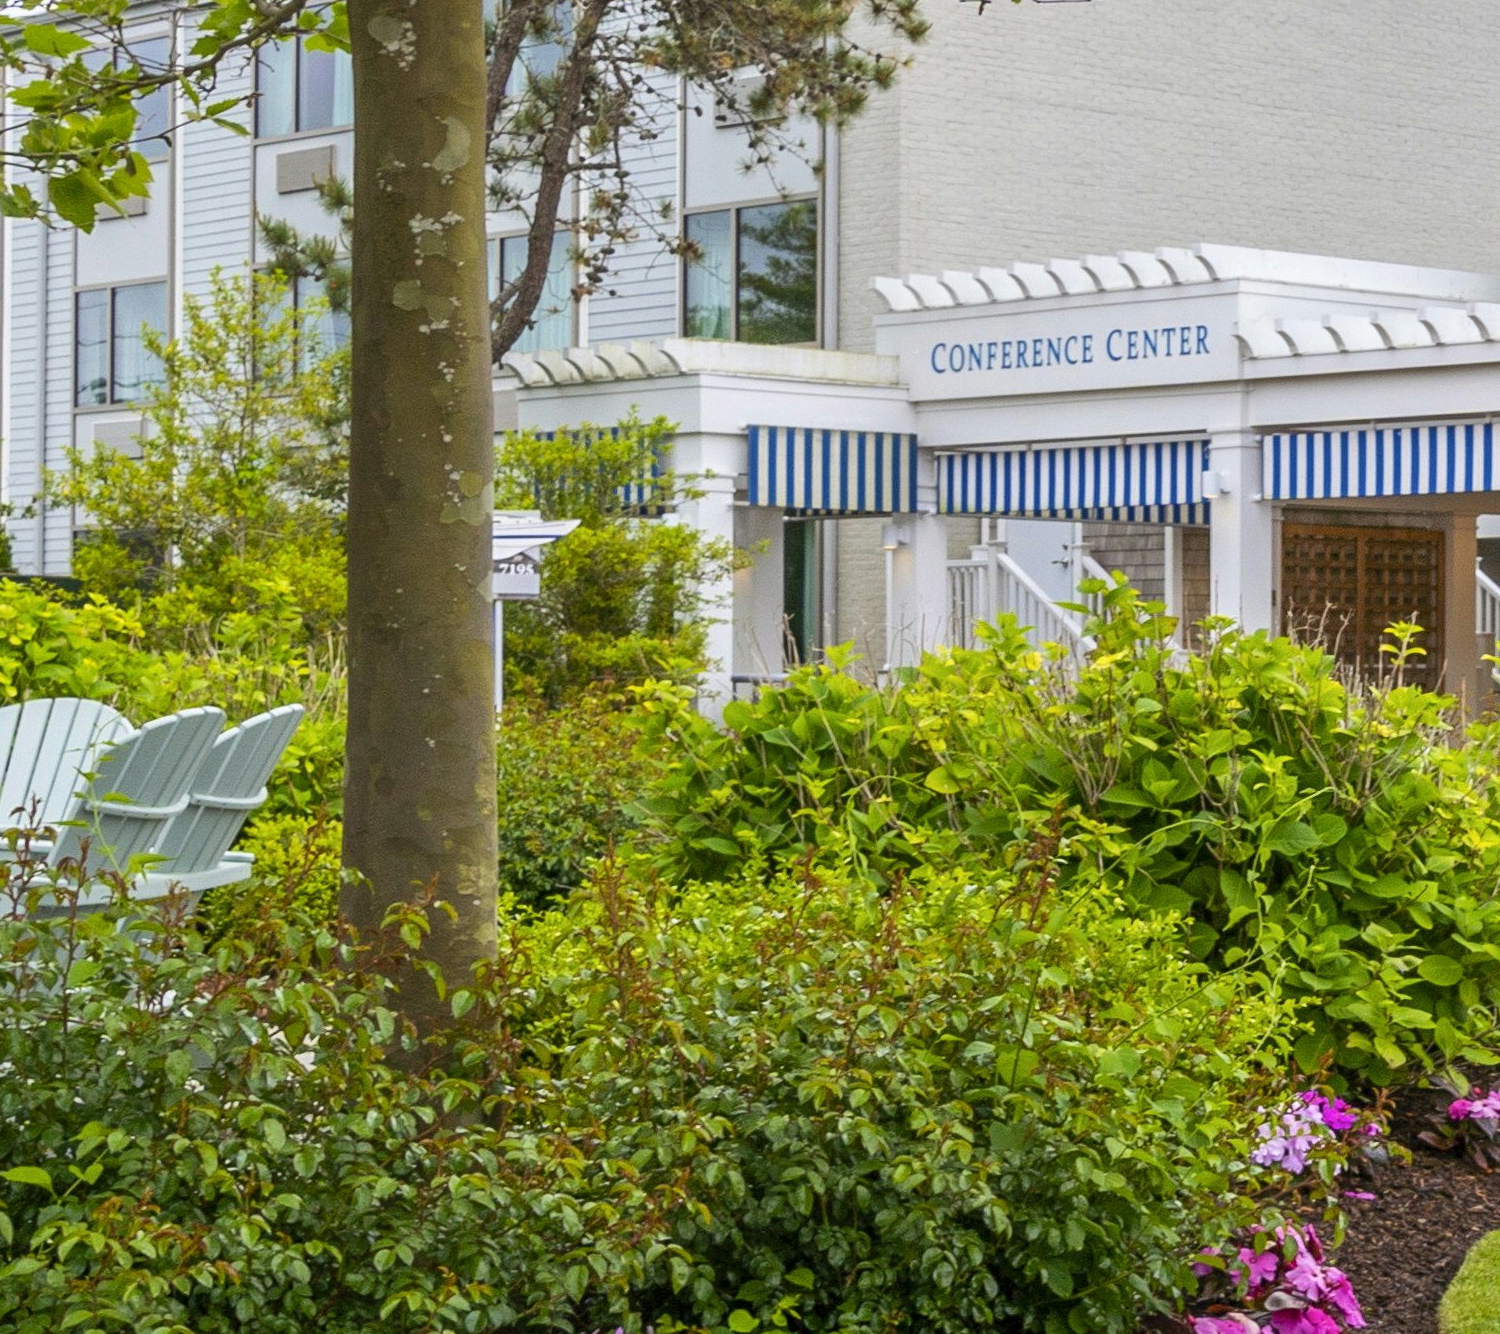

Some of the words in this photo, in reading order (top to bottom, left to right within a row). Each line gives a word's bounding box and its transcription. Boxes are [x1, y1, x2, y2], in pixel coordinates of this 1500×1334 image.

[930, 334, 1093, 374] CONFERENCE
[1105, 324, 1211, 363] CENTER
[498, 563, 535, 575] 7195
